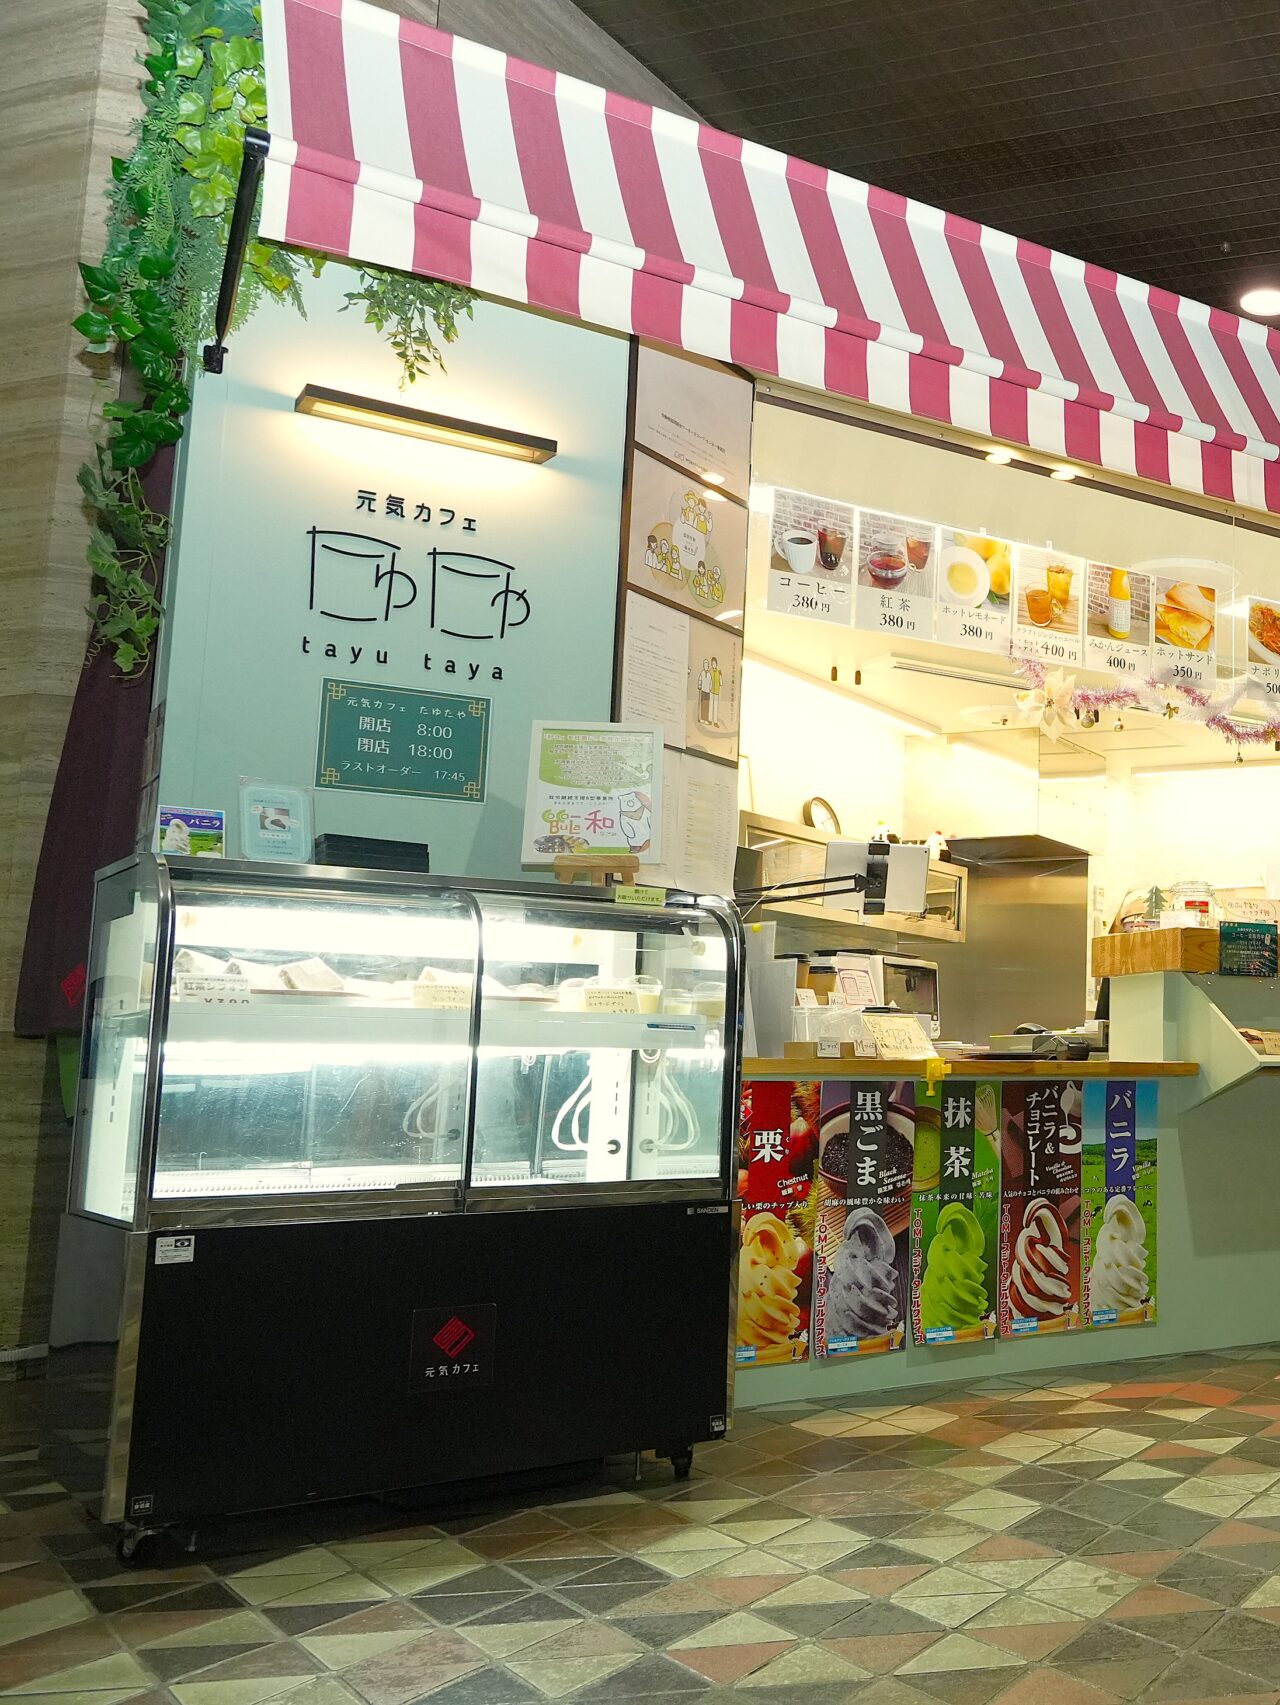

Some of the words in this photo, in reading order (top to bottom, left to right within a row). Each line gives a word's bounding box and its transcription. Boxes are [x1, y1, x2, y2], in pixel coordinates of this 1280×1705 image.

[356, 489, 477, 532] 元気カフェ
[779, 577, 846, 595] コーヒー
[879, 594, 911, 612] 紅茶
[941, 605, 1006, 625] ホットレモネード
[302, 636, 389, 664] tayu
[423, 653, 504, 680] taya
[1089, 639, 1148, 657] みかんジュース
[1156, 647, 1213, 665] ホットサンド
[347, 696, 407, 712] 元気カフェ
[419, 706, 466, 720] たゆたや
[359, 716, 392, 733] 開店
[416, 723, 453, 739] 8:00
[357, 737, 391, 755] 閉店
[408, 744, 453, 760] 18:00
[341, 760, 422, 776] ラストオーダー
[433, 770, 466, 782] 17:45
[188, 818, 221, 827] バニラ
[584, 809, 615, 834] 和
[854, 1090, 884, 1186] 黒ごま
[943, 1097, 972, 1178] 抹茶
[1026, 1092, 1042, 1187] チョコレート
[1109, 1090, 1132, 1172] バニラ
[751, 1128, 784, 1164] 栗
[777, 1173, 809, 1188] Chestnut
[878, 1166, 897, 1179] Black
[883, 1173, 907, 1185] Sesame
[424, 1363, 480, 1378] 元気カフェ
